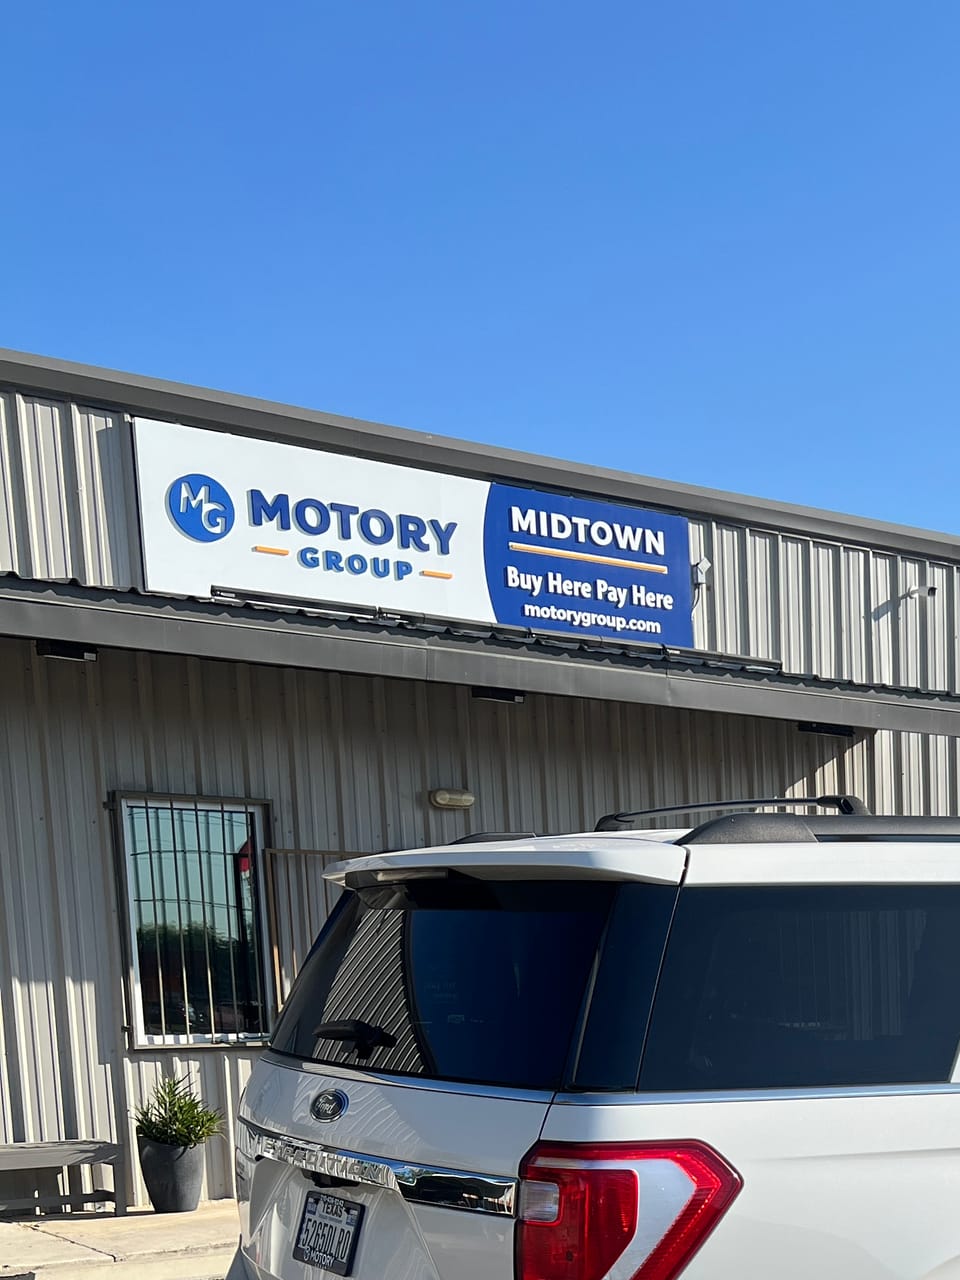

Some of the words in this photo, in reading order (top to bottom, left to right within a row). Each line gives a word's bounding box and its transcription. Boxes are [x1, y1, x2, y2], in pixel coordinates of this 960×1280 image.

[248, 489, 458, 555] MOTORY
[510, 506, 665, 556] MIDTOWN
[298, 547, 413, 581] GROUP
[506, 565, 543, 597] Buy
[547, 571, 592, 599] Here
[596, 579, 628, 609] Pay
[631, 584, 674, 610] Here
[523, 603, 661, 633] motorygroup.com
[315, 1093, 337, 1114] Ford
[321, 1202, 343, 1218] TEXAS
[310, 1249, 335, 1267] MOTORY
